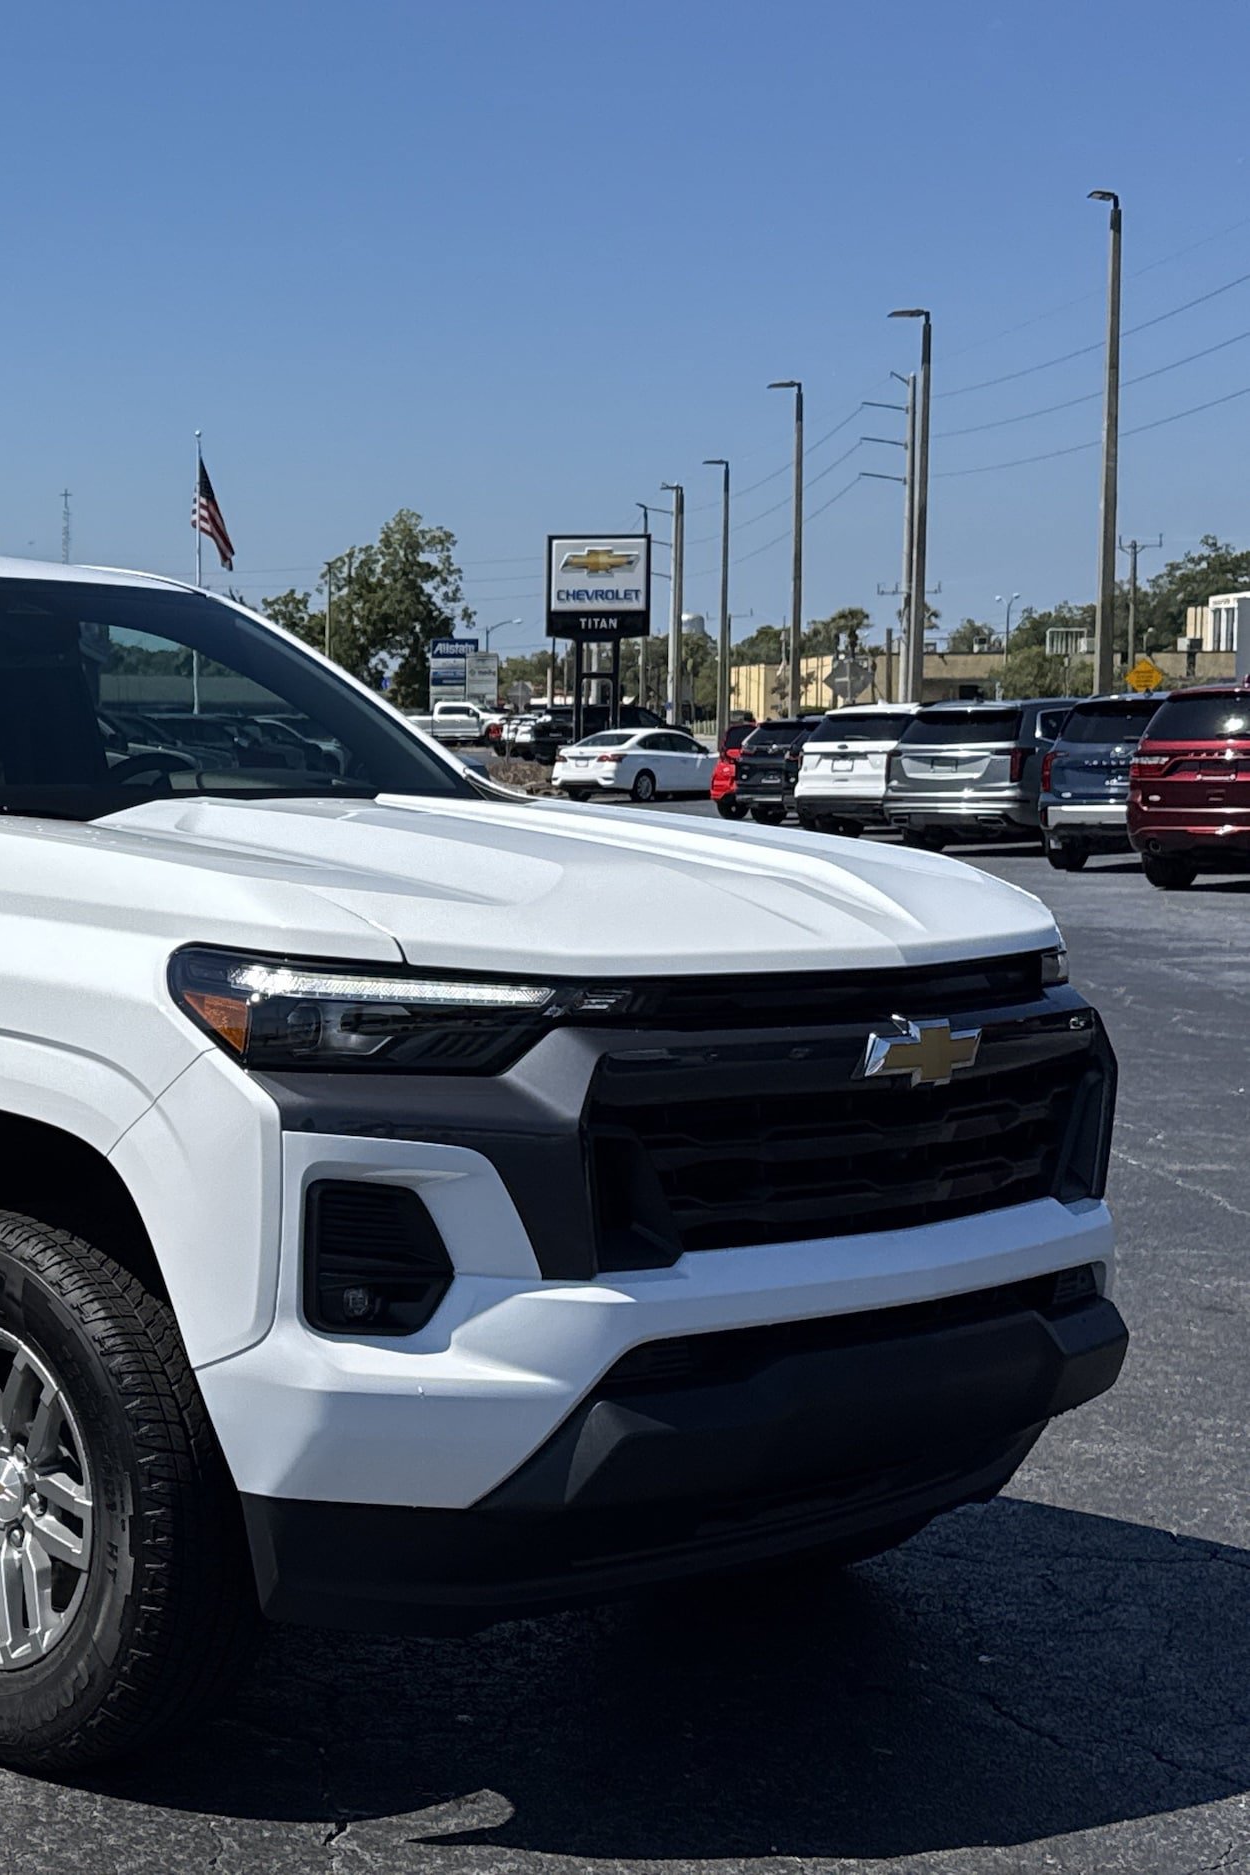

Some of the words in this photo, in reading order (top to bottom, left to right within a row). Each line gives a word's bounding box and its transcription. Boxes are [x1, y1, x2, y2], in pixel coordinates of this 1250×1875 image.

[556, 589, 642, 602] CHEVROLET
[579, 617, 617, 629] TITAN
[433, 642, 475, 655] Allstate
